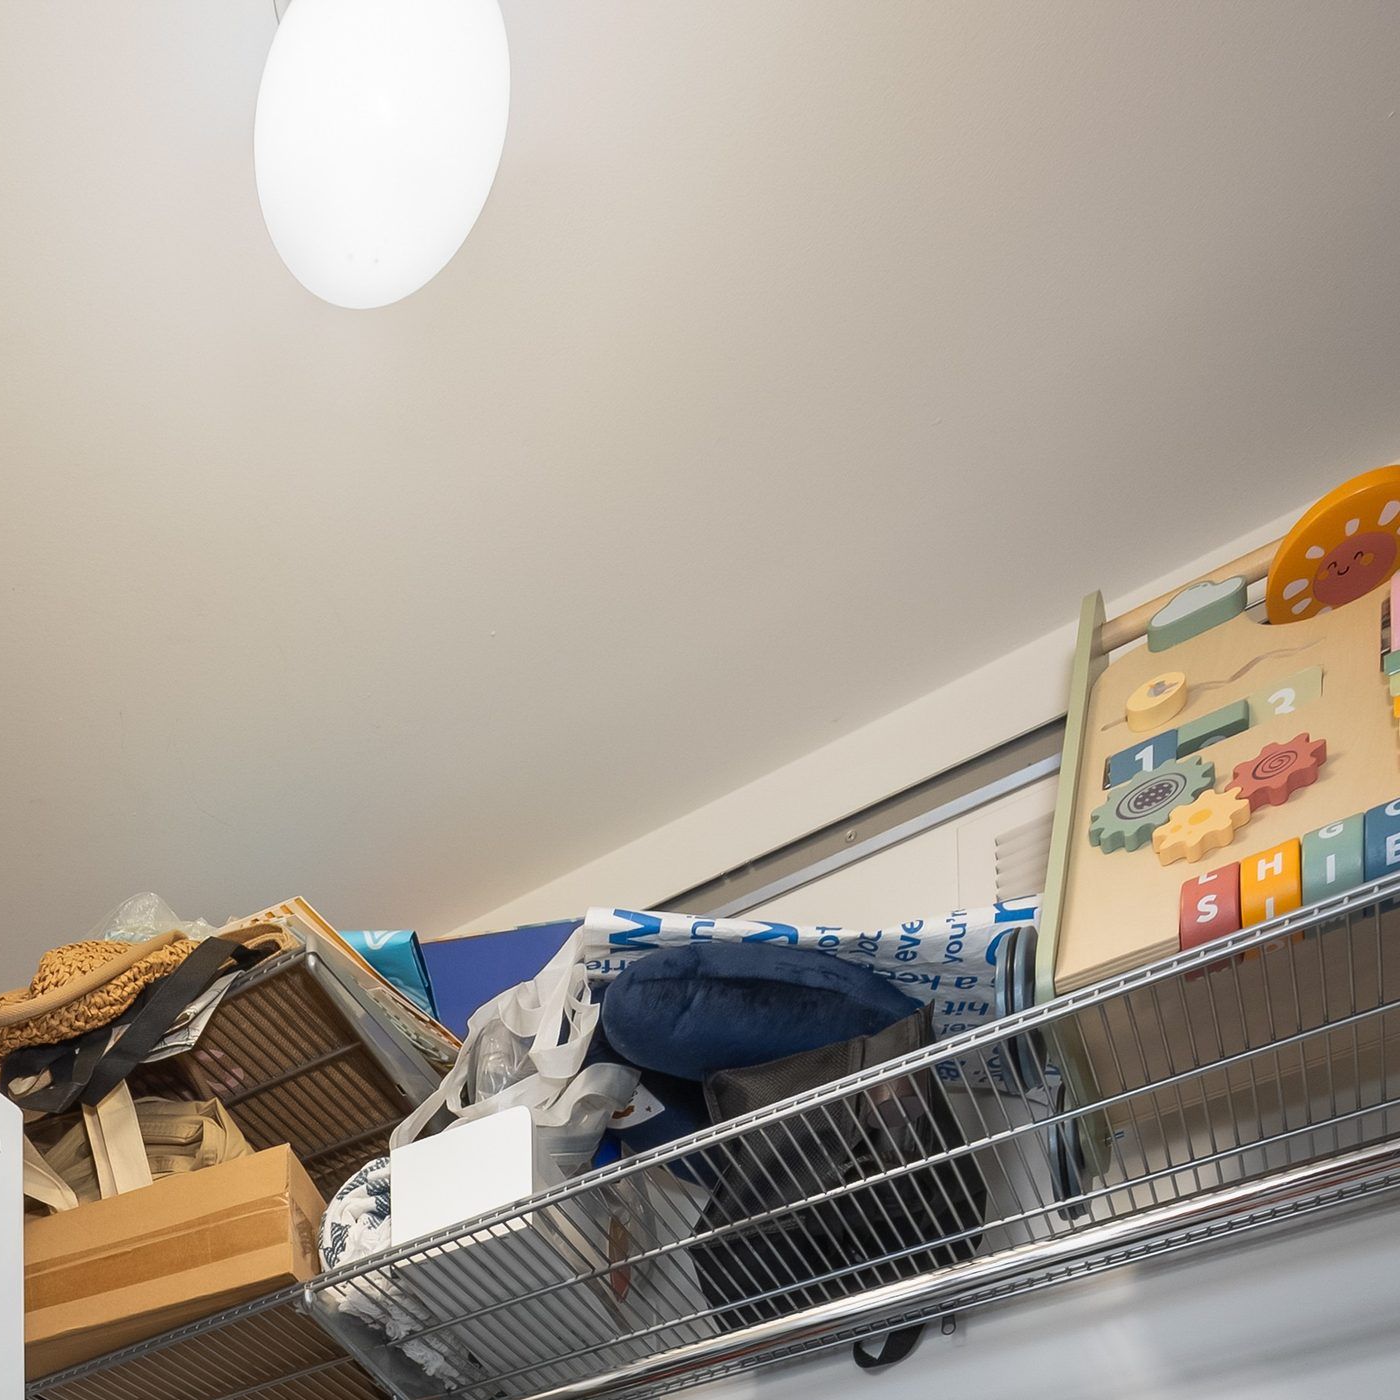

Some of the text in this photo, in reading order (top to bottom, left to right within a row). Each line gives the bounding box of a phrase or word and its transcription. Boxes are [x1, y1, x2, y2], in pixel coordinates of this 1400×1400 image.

[1267, 688, 1296, 714] 2
[1134, 745, 1154, 772] 1
[1196, 894, 1218, 923] S
[1257, 851, 1283, 882] H
